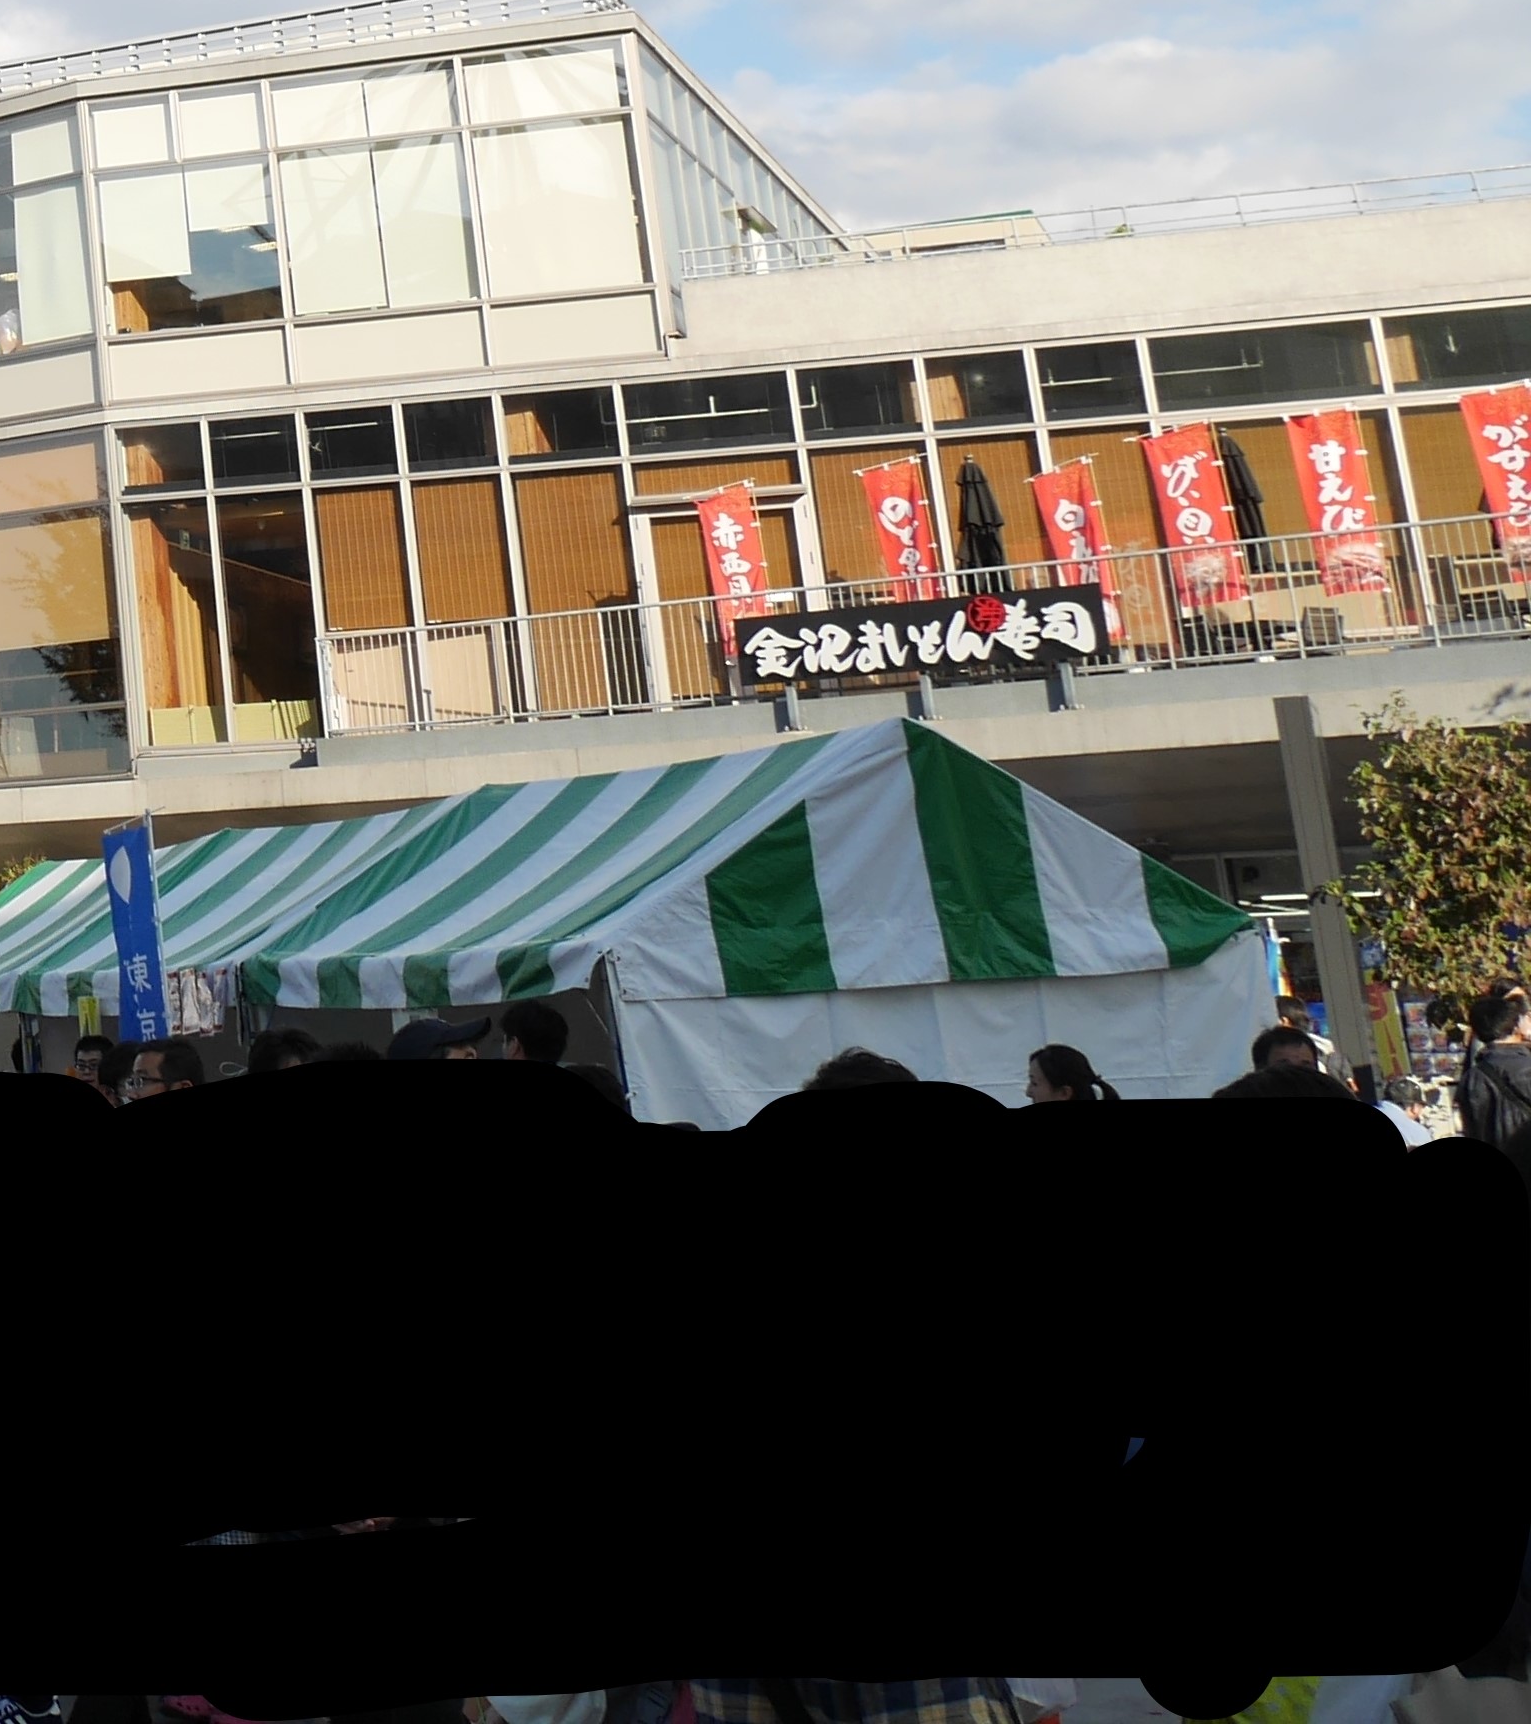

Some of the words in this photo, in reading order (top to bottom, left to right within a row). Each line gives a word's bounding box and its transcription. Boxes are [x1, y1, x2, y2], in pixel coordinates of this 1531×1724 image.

[1161, 449, 1217, 545] ばい貝
[1307, 439, 1366, 539] 甘えび
[711, 512, 752, 607] 赤西貝
[744, 597, 1097, 678] 金沢まいもん寿司
